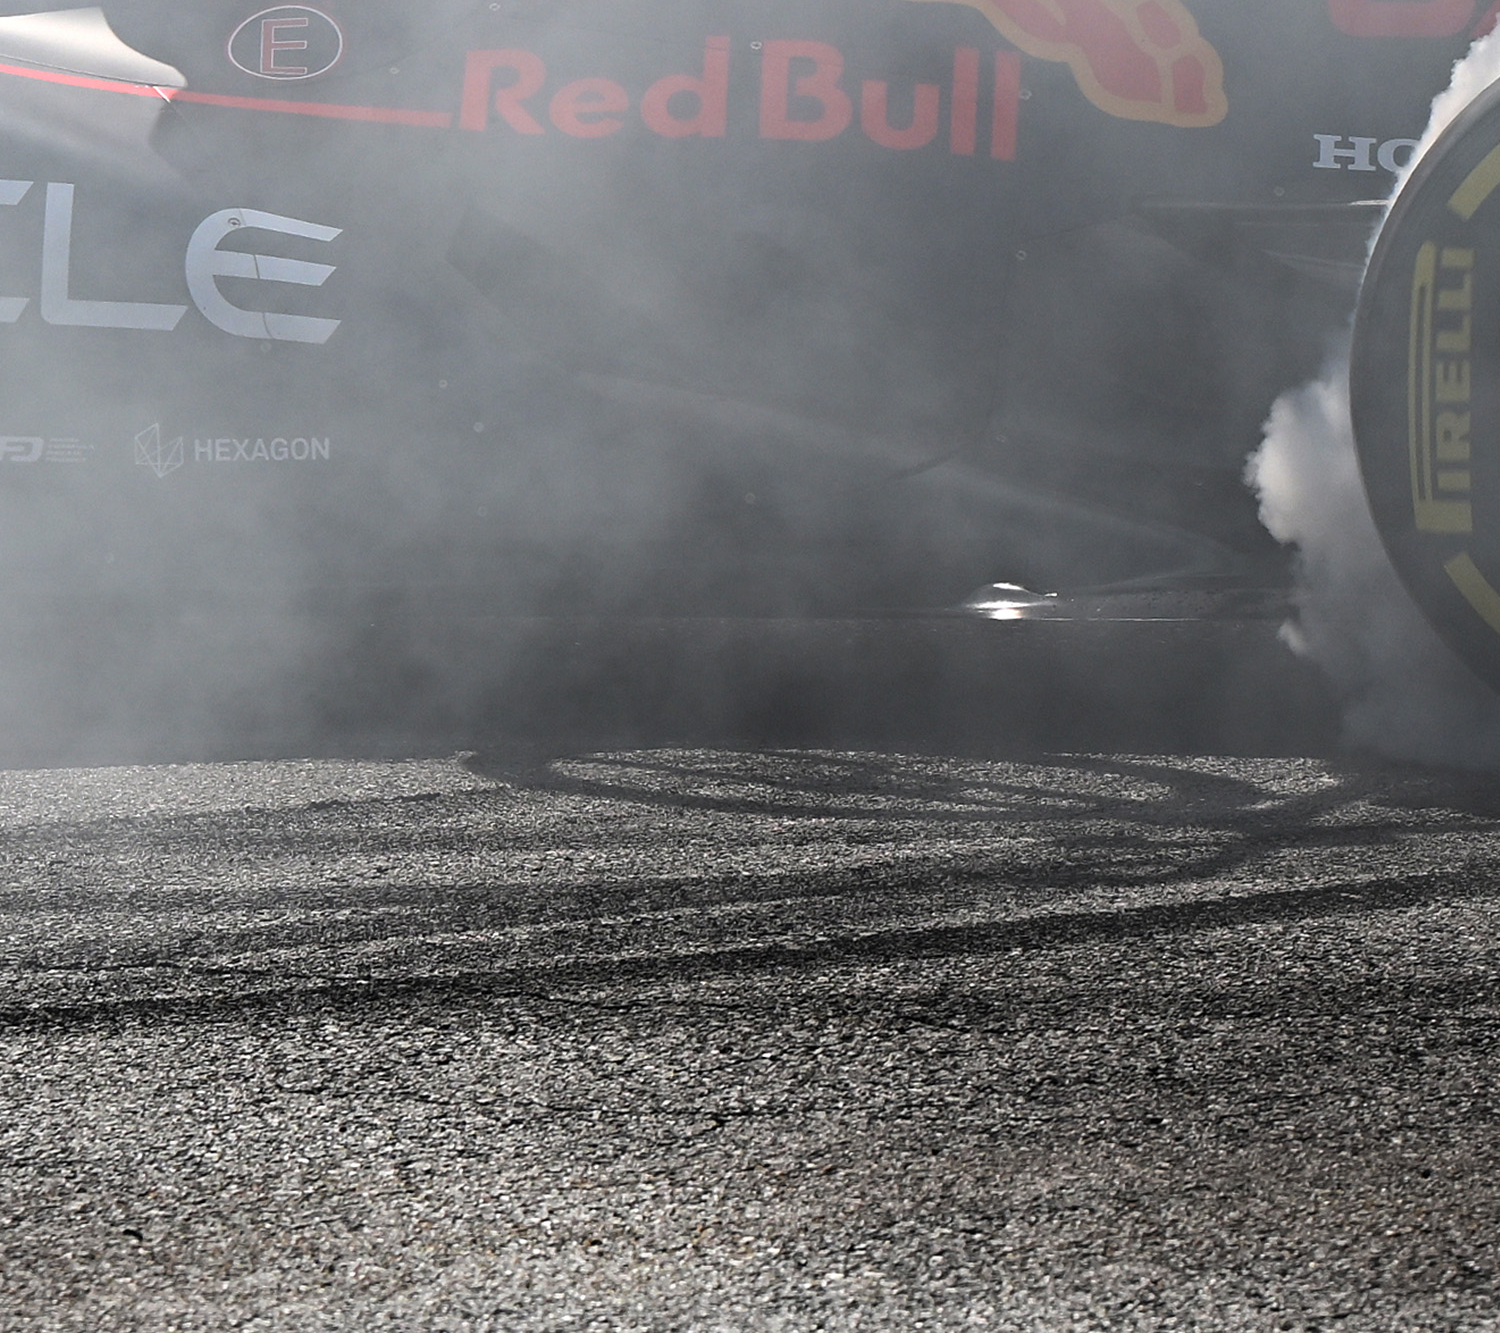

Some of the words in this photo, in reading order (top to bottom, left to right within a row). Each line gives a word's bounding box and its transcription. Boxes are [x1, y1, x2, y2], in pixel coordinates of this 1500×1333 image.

[258, 17, 309, 76] E
[458, 35, 732, 139] Red
[759, 38, 1022, 162] Bull
[1409, 241, 1476, 534] PIRELLI
[193, 437, 331, 462] HEXAGON
